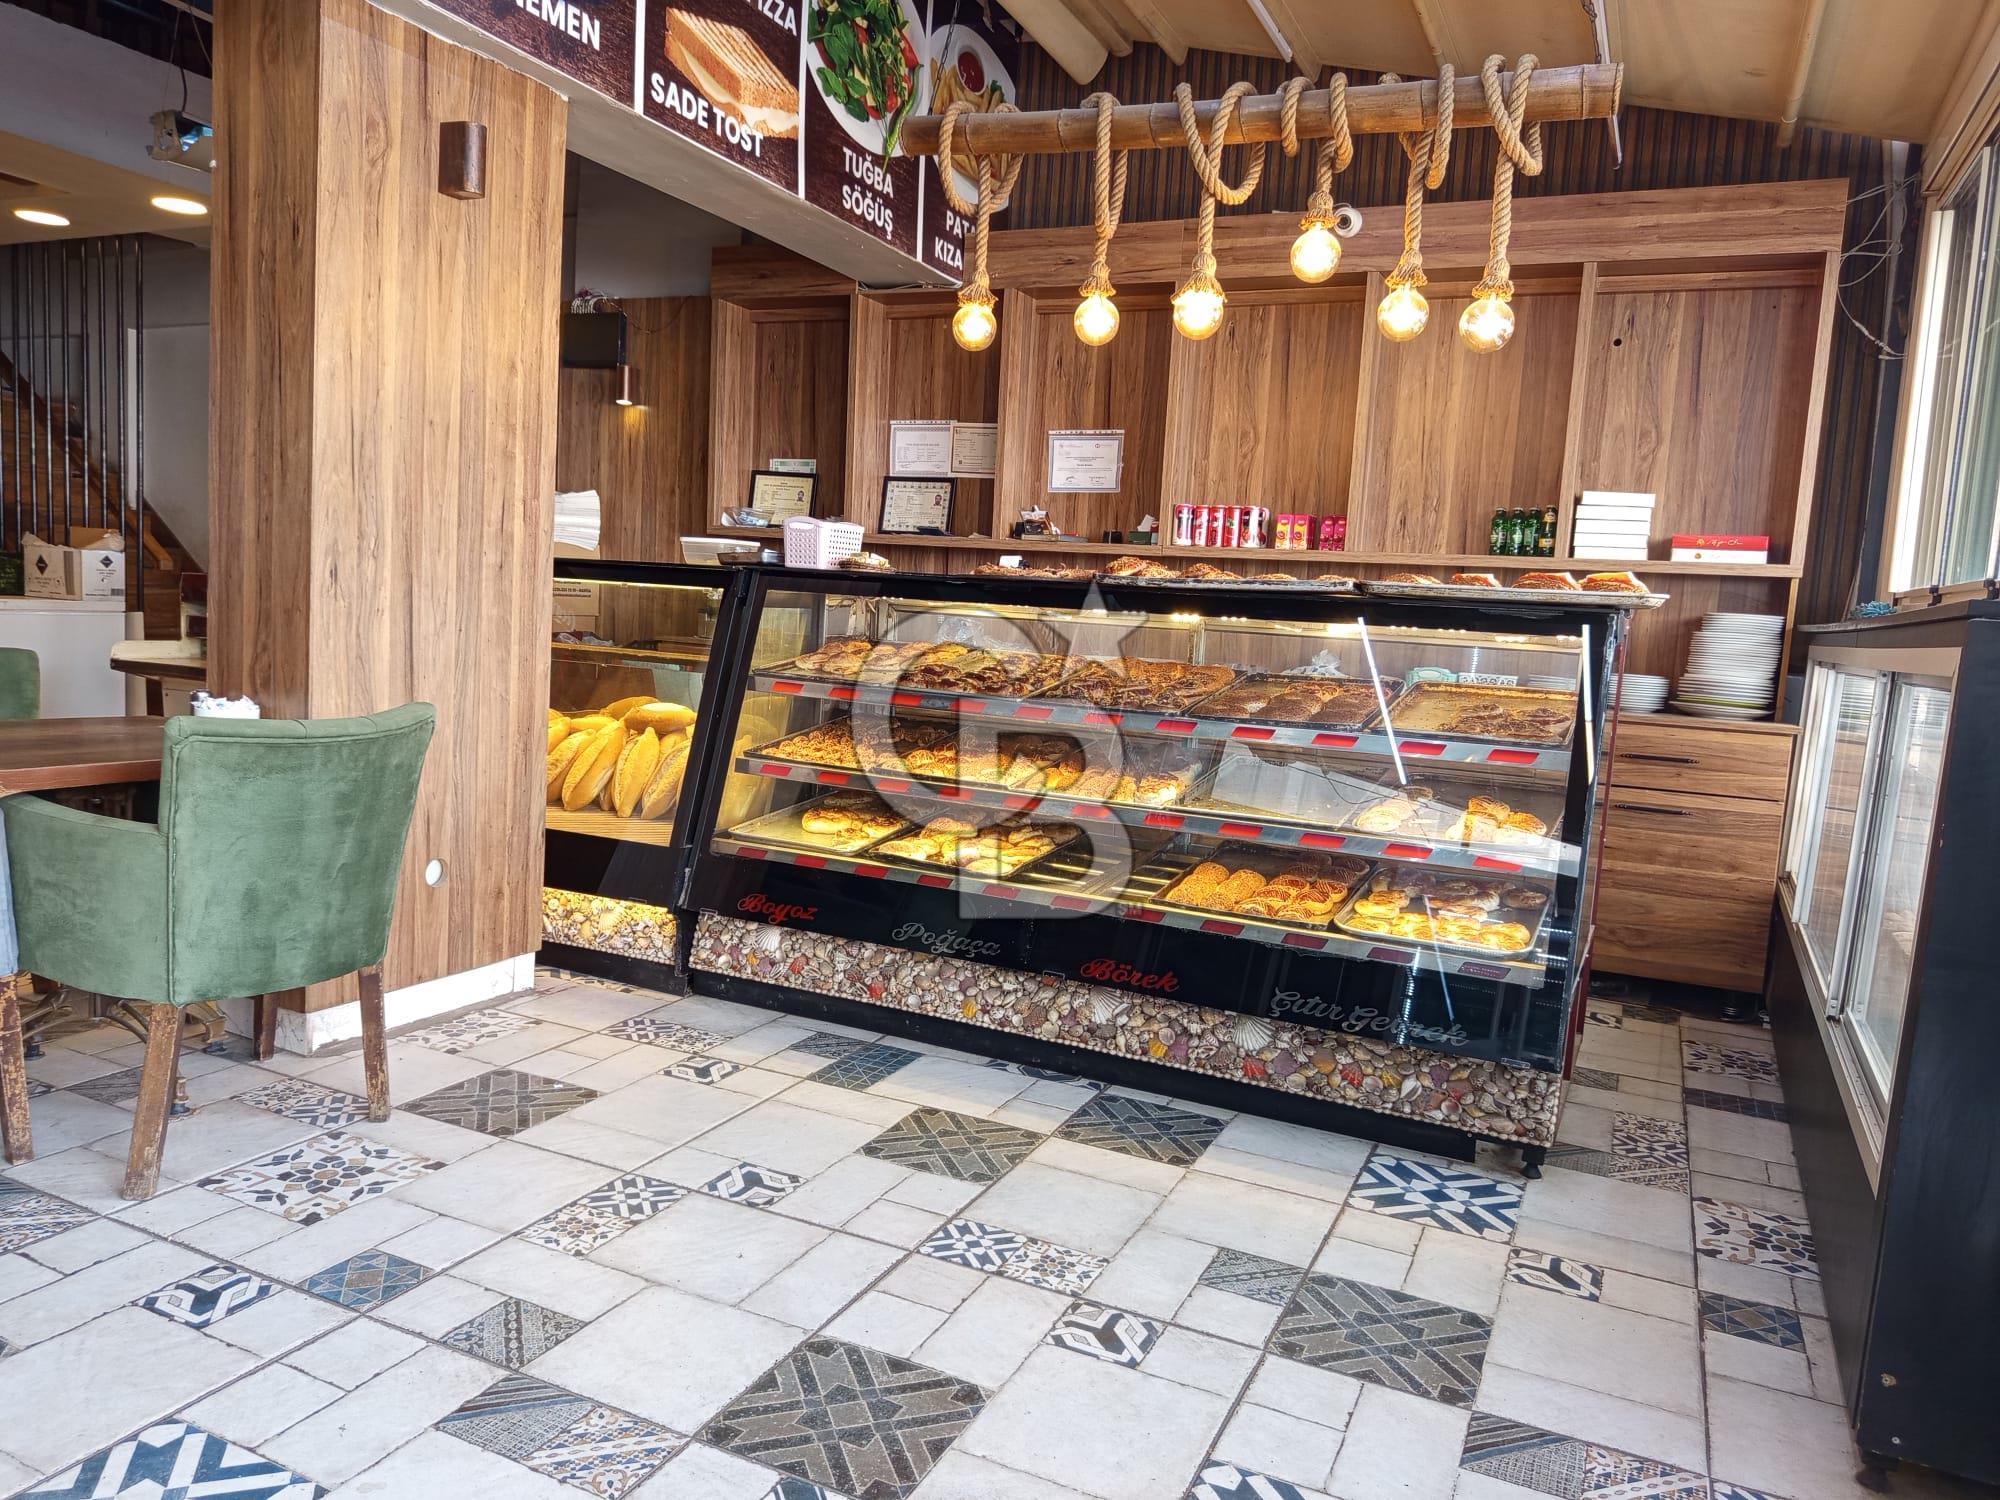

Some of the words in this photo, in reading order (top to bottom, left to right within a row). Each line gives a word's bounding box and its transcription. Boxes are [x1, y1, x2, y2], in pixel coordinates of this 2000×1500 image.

[516, 0, 600, 51] EMEN
[746, 0, 797, 37] ZZA
[651, 72, 709, 129] SADE
[712, 105, 764, 158] TOST
[842, 146, 894, 199] TUĞBA
[842, 184, 894, 240] SÖĞÜŞ
[737, 893, 818, 925] Boyoz
[892, 922, 1001, 958] Poğaça
[1081, 958, 1180, 992] Börek
[1268, 986, 1346, 1021] Çıtır
